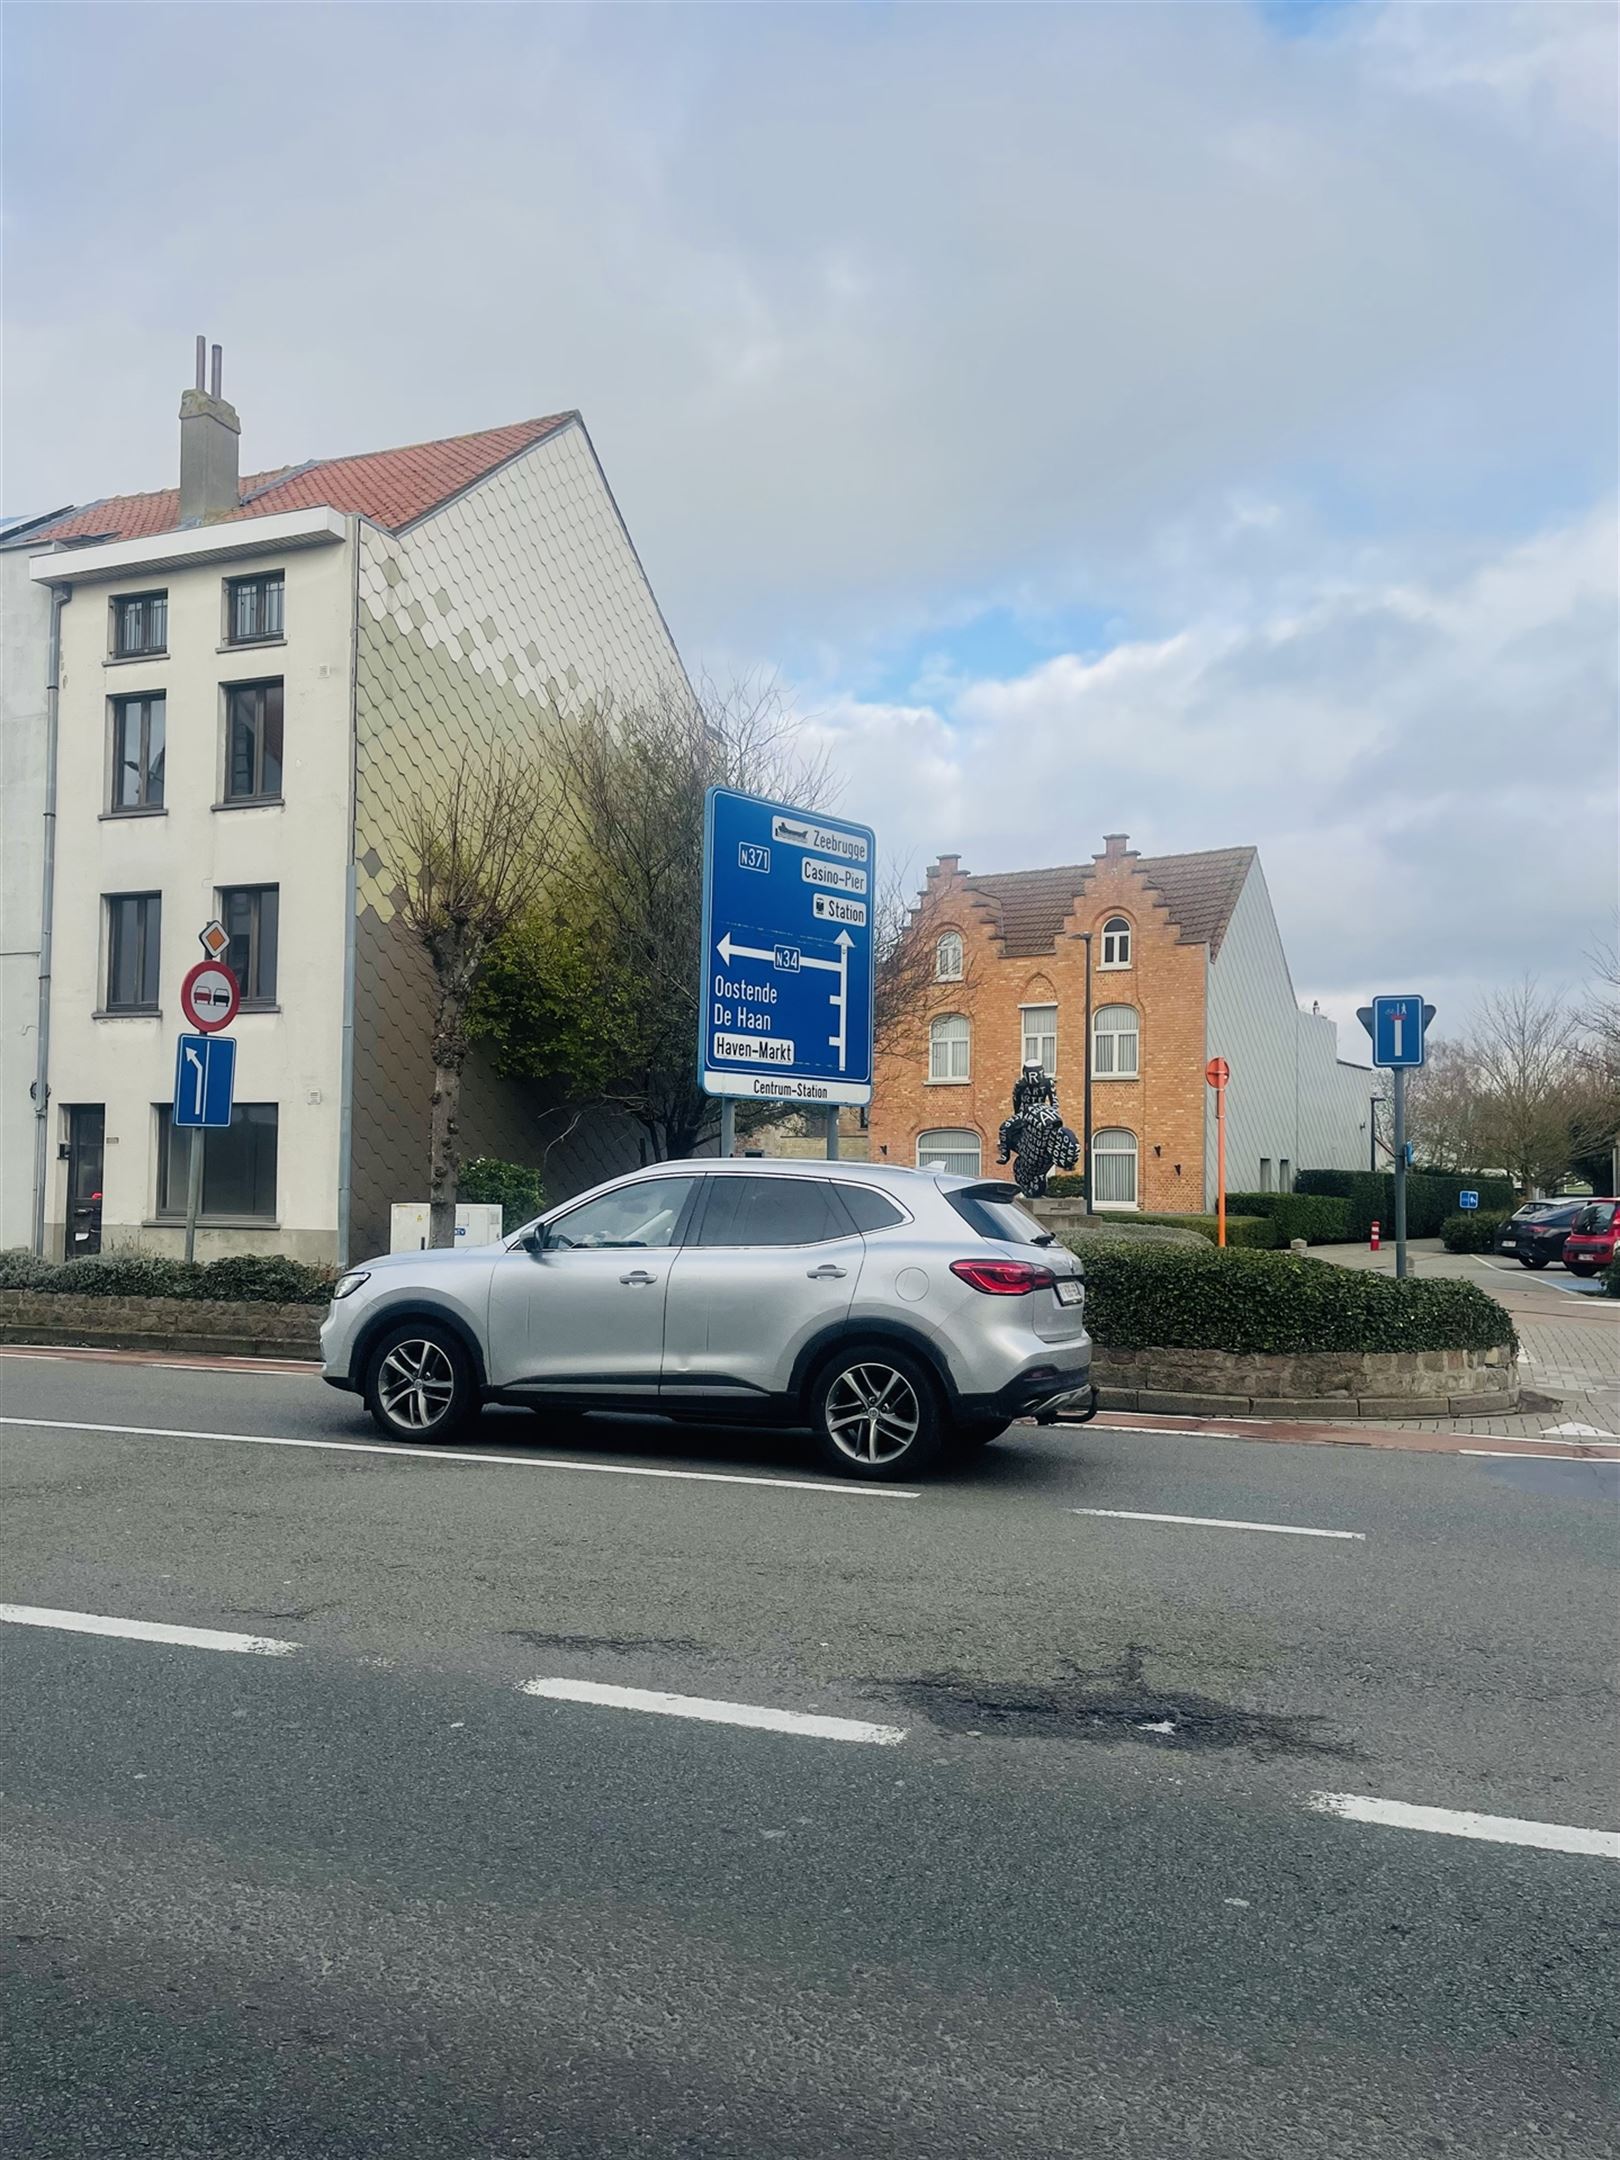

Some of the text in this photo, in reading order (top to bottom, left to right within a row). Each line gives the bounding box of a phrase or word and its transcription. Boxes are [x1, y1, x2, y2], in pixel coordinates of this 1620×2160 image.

[813, 830, 865, 861] Zeebrugge
[741, 847, 768, 869] N371
[804, 862, 864, 890] Casino-Pier
[828, 900, 864, 923] Station
[776, 950, 798, 969] N34
[715, 975, 777, 1004] Oostende
[714, 1003, 771, 1031] De Haan
[716, 1037, 792, 1061] Haven-Markt
[753, 1079, 828, 1099] Centrum-Station
